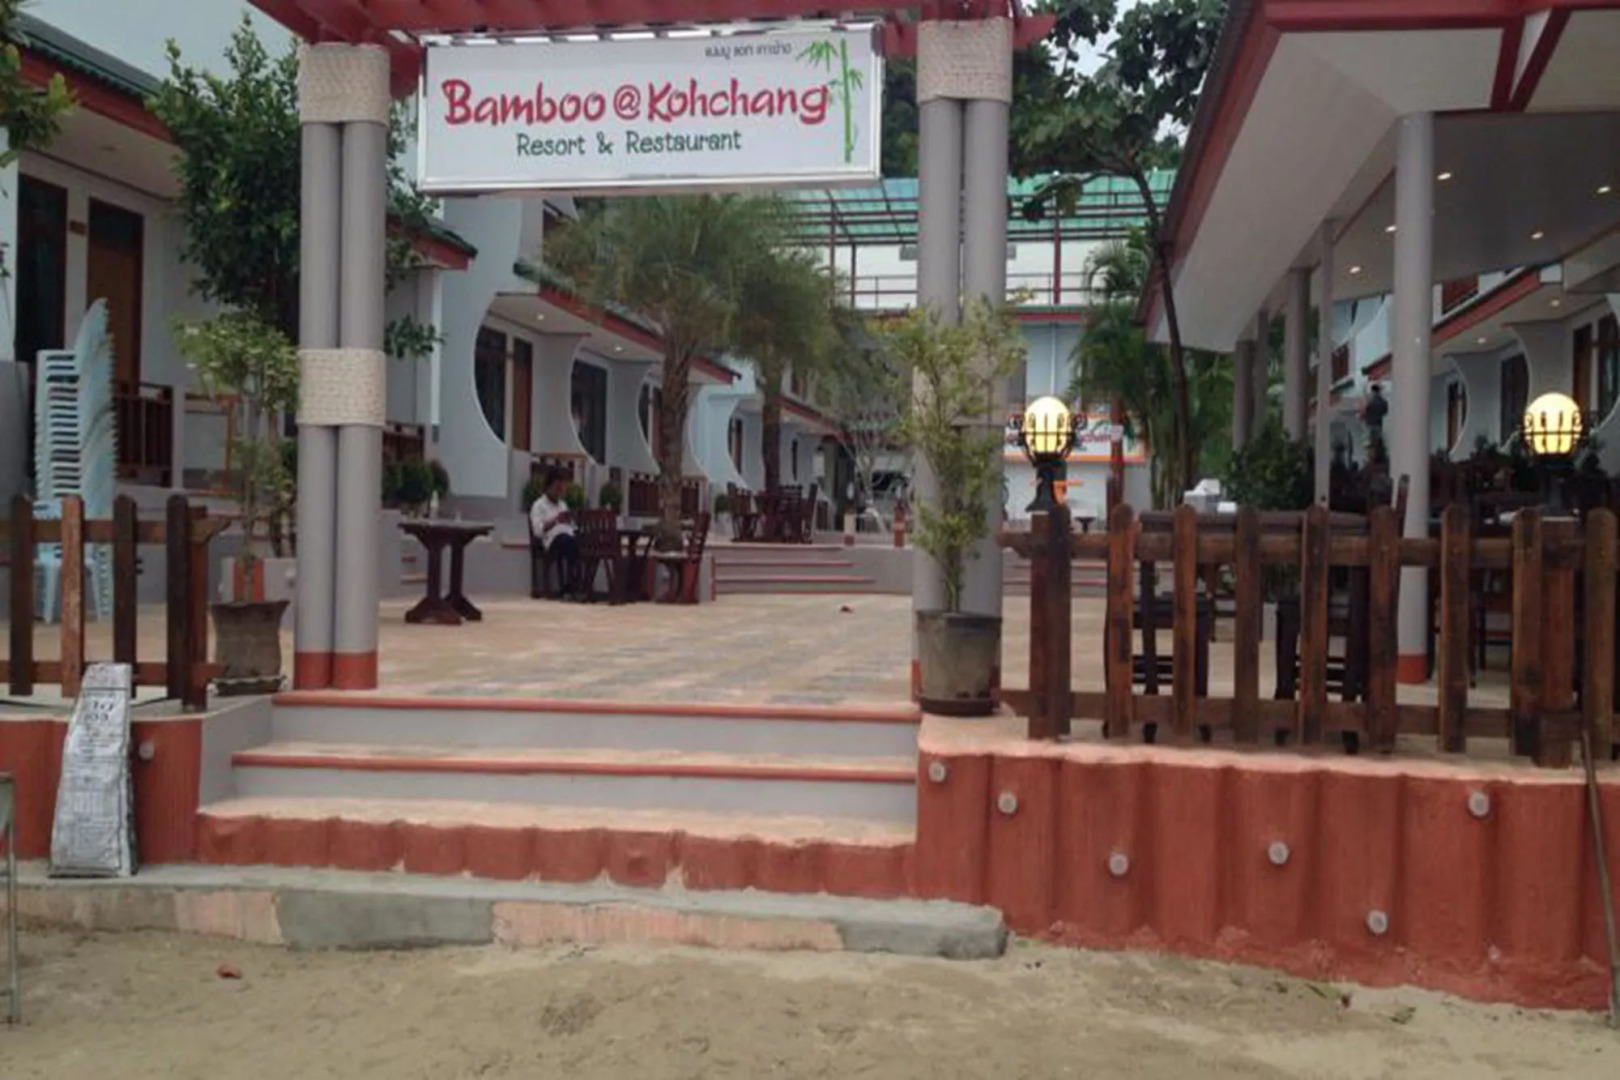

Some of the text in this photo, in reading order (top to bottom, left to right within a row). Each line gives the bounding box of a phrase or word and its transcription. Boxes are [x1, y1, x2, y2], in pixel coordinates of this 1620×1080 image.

[516, 130, 742, 156] Resort & Restaurant
